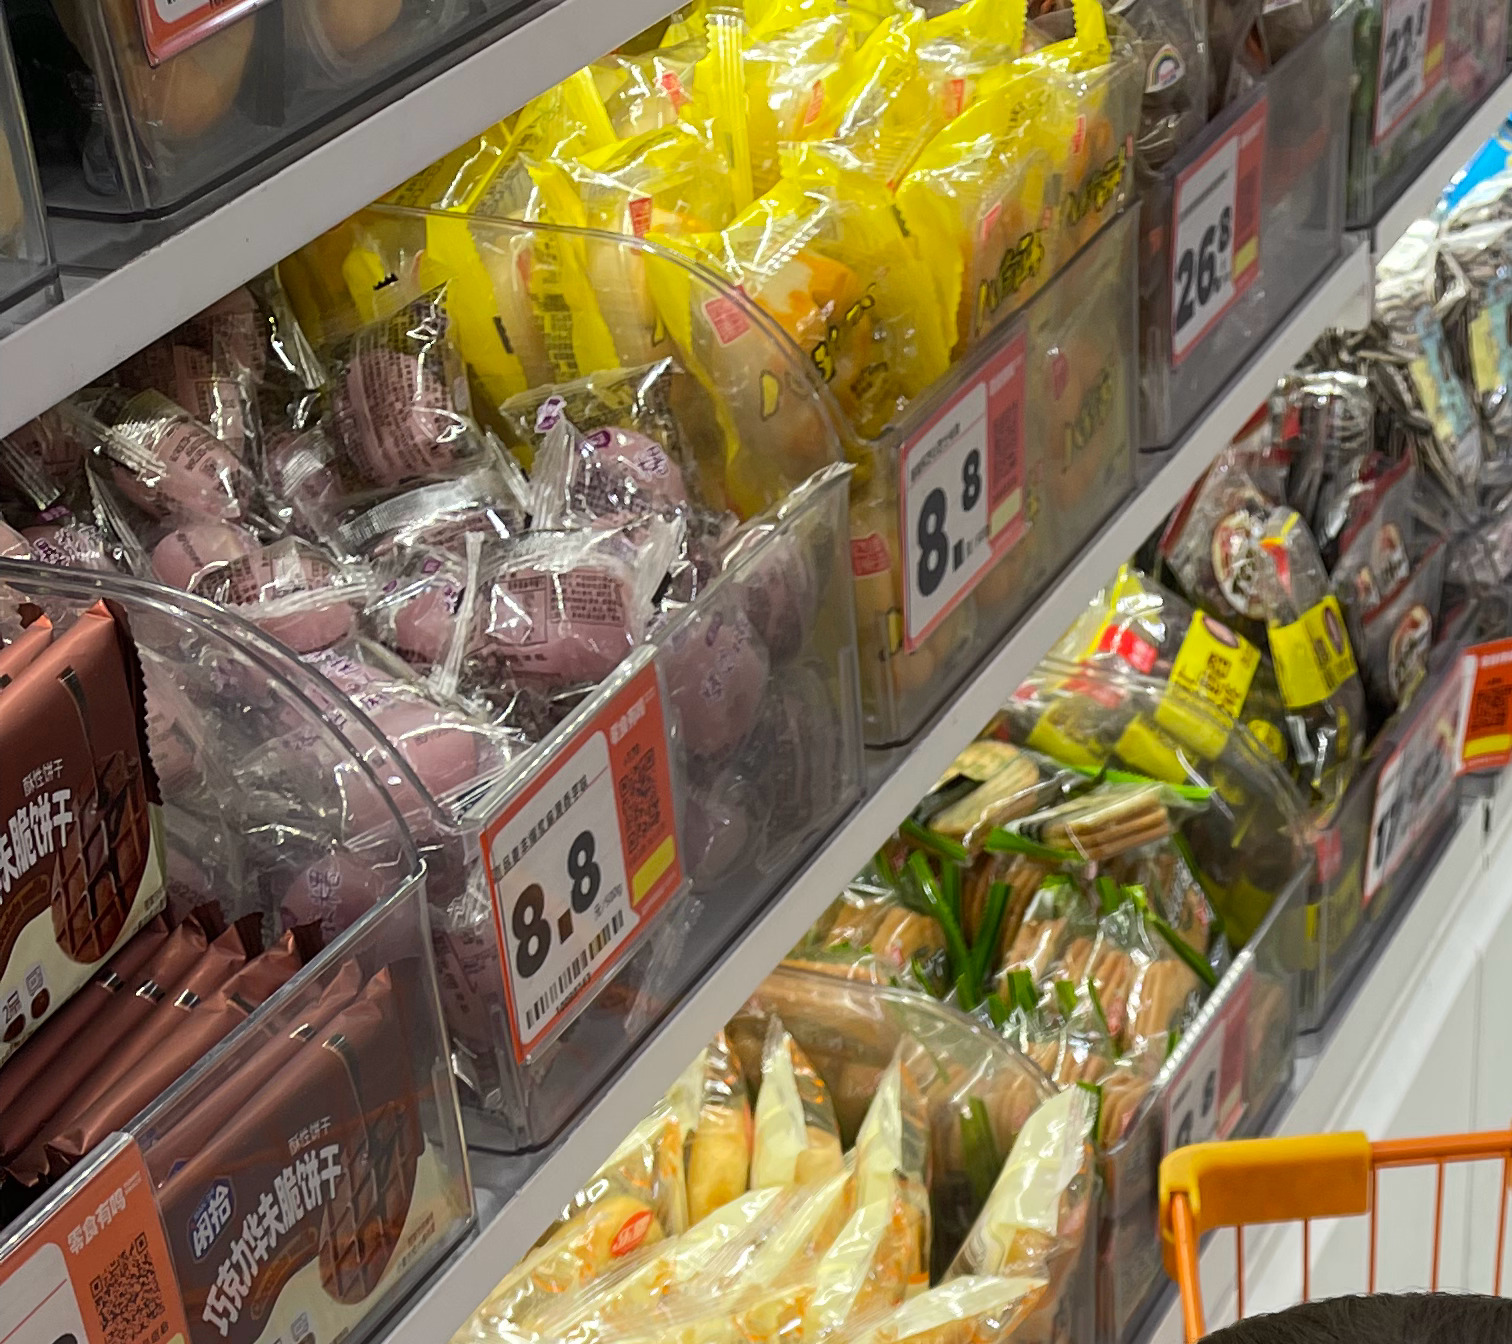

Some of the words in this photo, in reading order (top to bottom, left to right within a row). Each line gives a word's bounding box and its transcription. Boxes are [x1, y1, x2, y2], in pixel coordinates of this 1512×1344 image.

[917, 448, 982, 597] 8.8
[511, 829, 602, 980] 8.8
[202, 1144, 342, 1337] 巧克力华夫脆饼干
